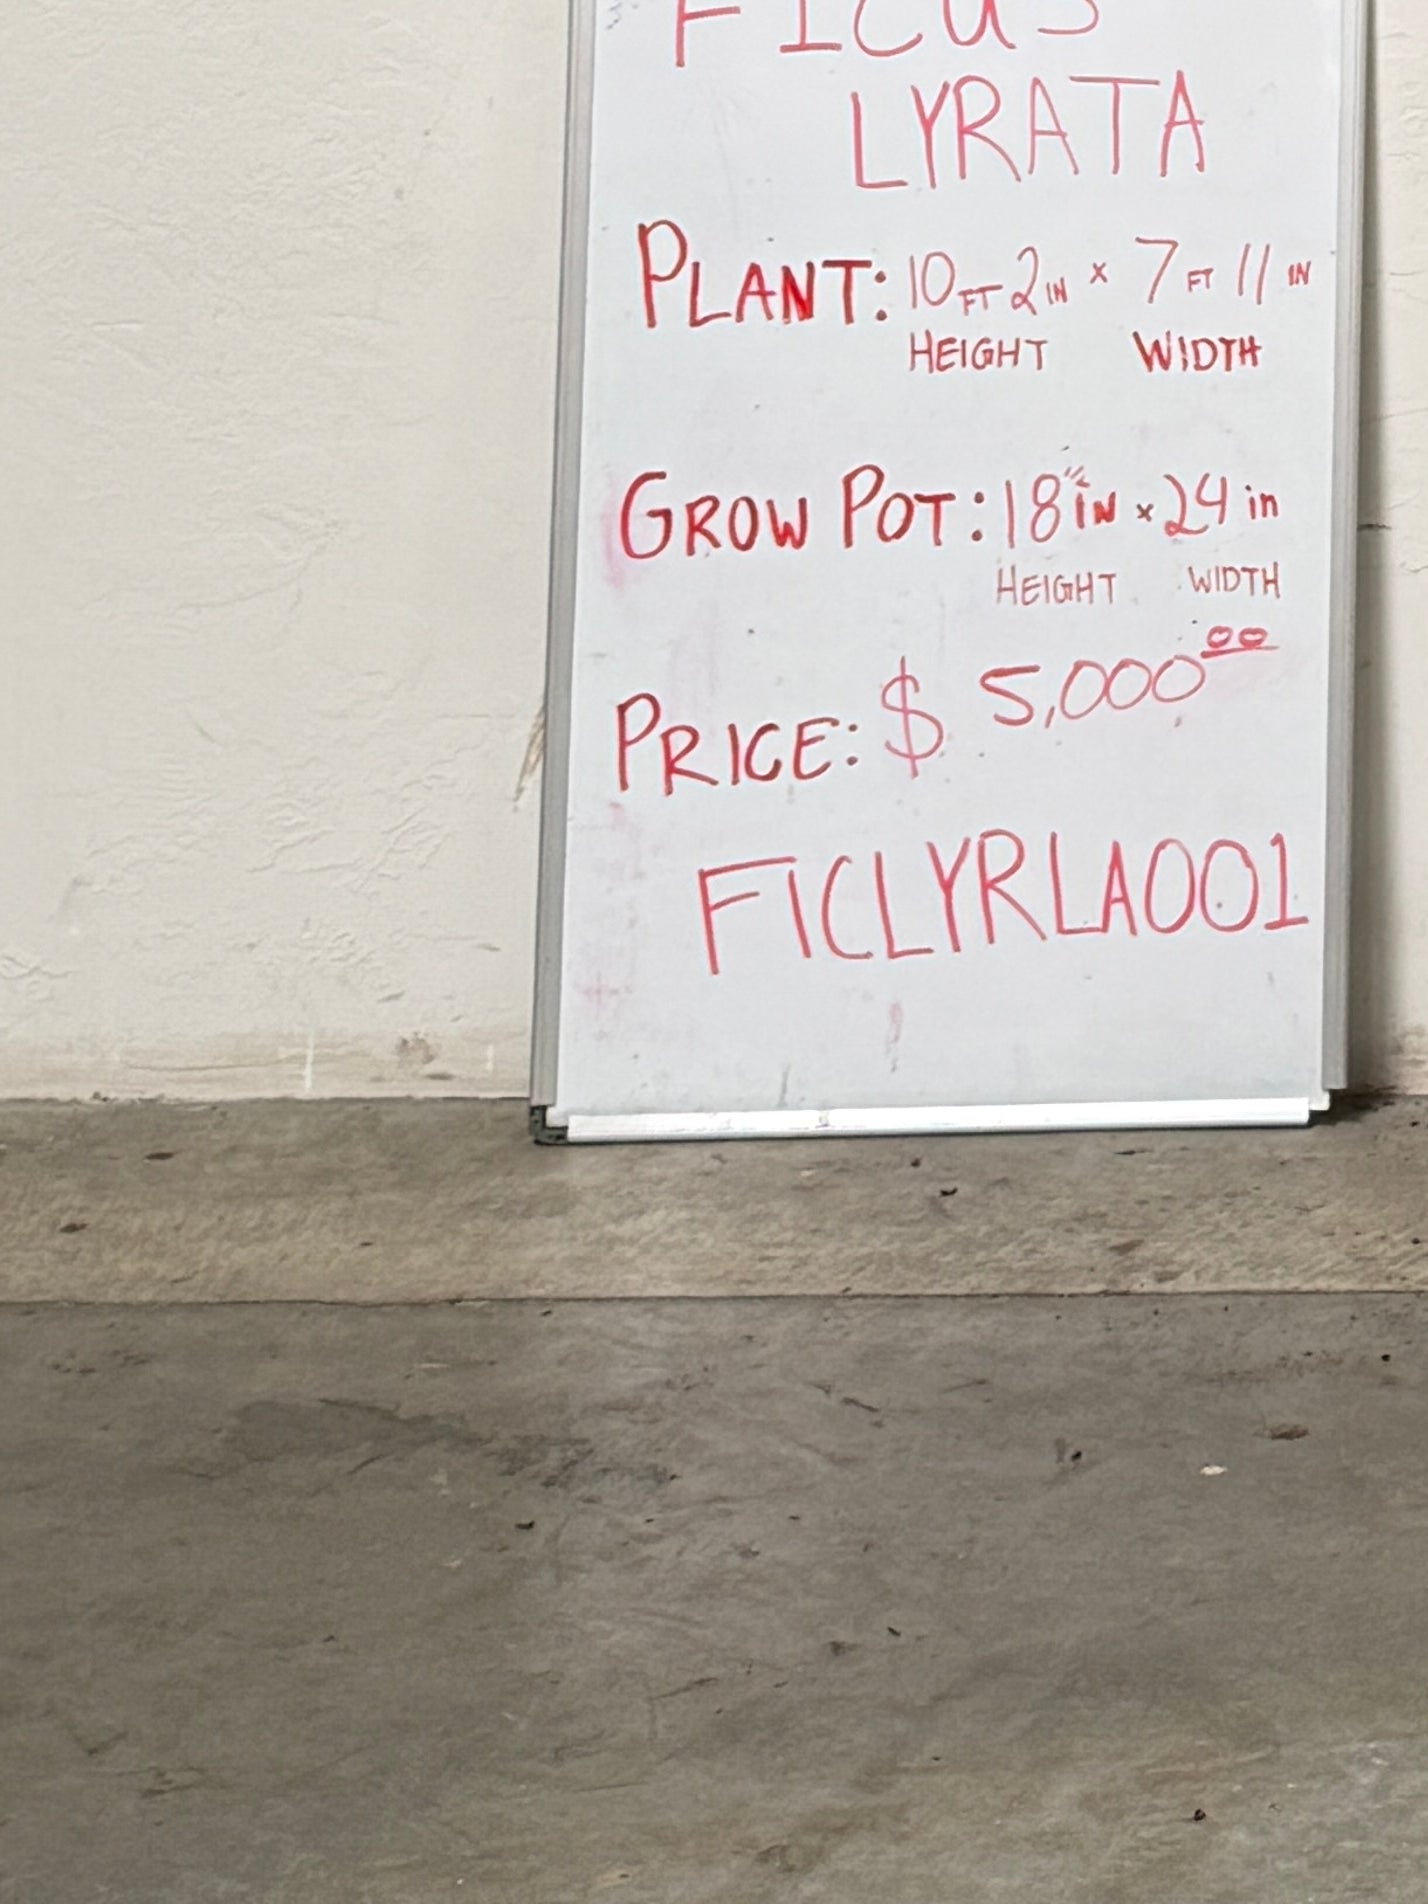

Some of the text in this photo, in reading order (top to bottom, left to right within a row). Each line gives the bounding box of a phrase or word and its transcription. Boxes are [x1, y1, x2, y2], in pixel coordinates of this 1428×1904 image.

[850, 71, 1207, 190] LYRATA
[636, 220, 888, 329] PLANT:
[909, 329, 1262, 374] HEIGHT WIDTH
[617, 471, 809, 562] GROW
[841, 464, 986, 551] POT:
[996, 561, 1281, 606] HEIGHT WIDTH
[613, 691, 861, 796] PRICE:
